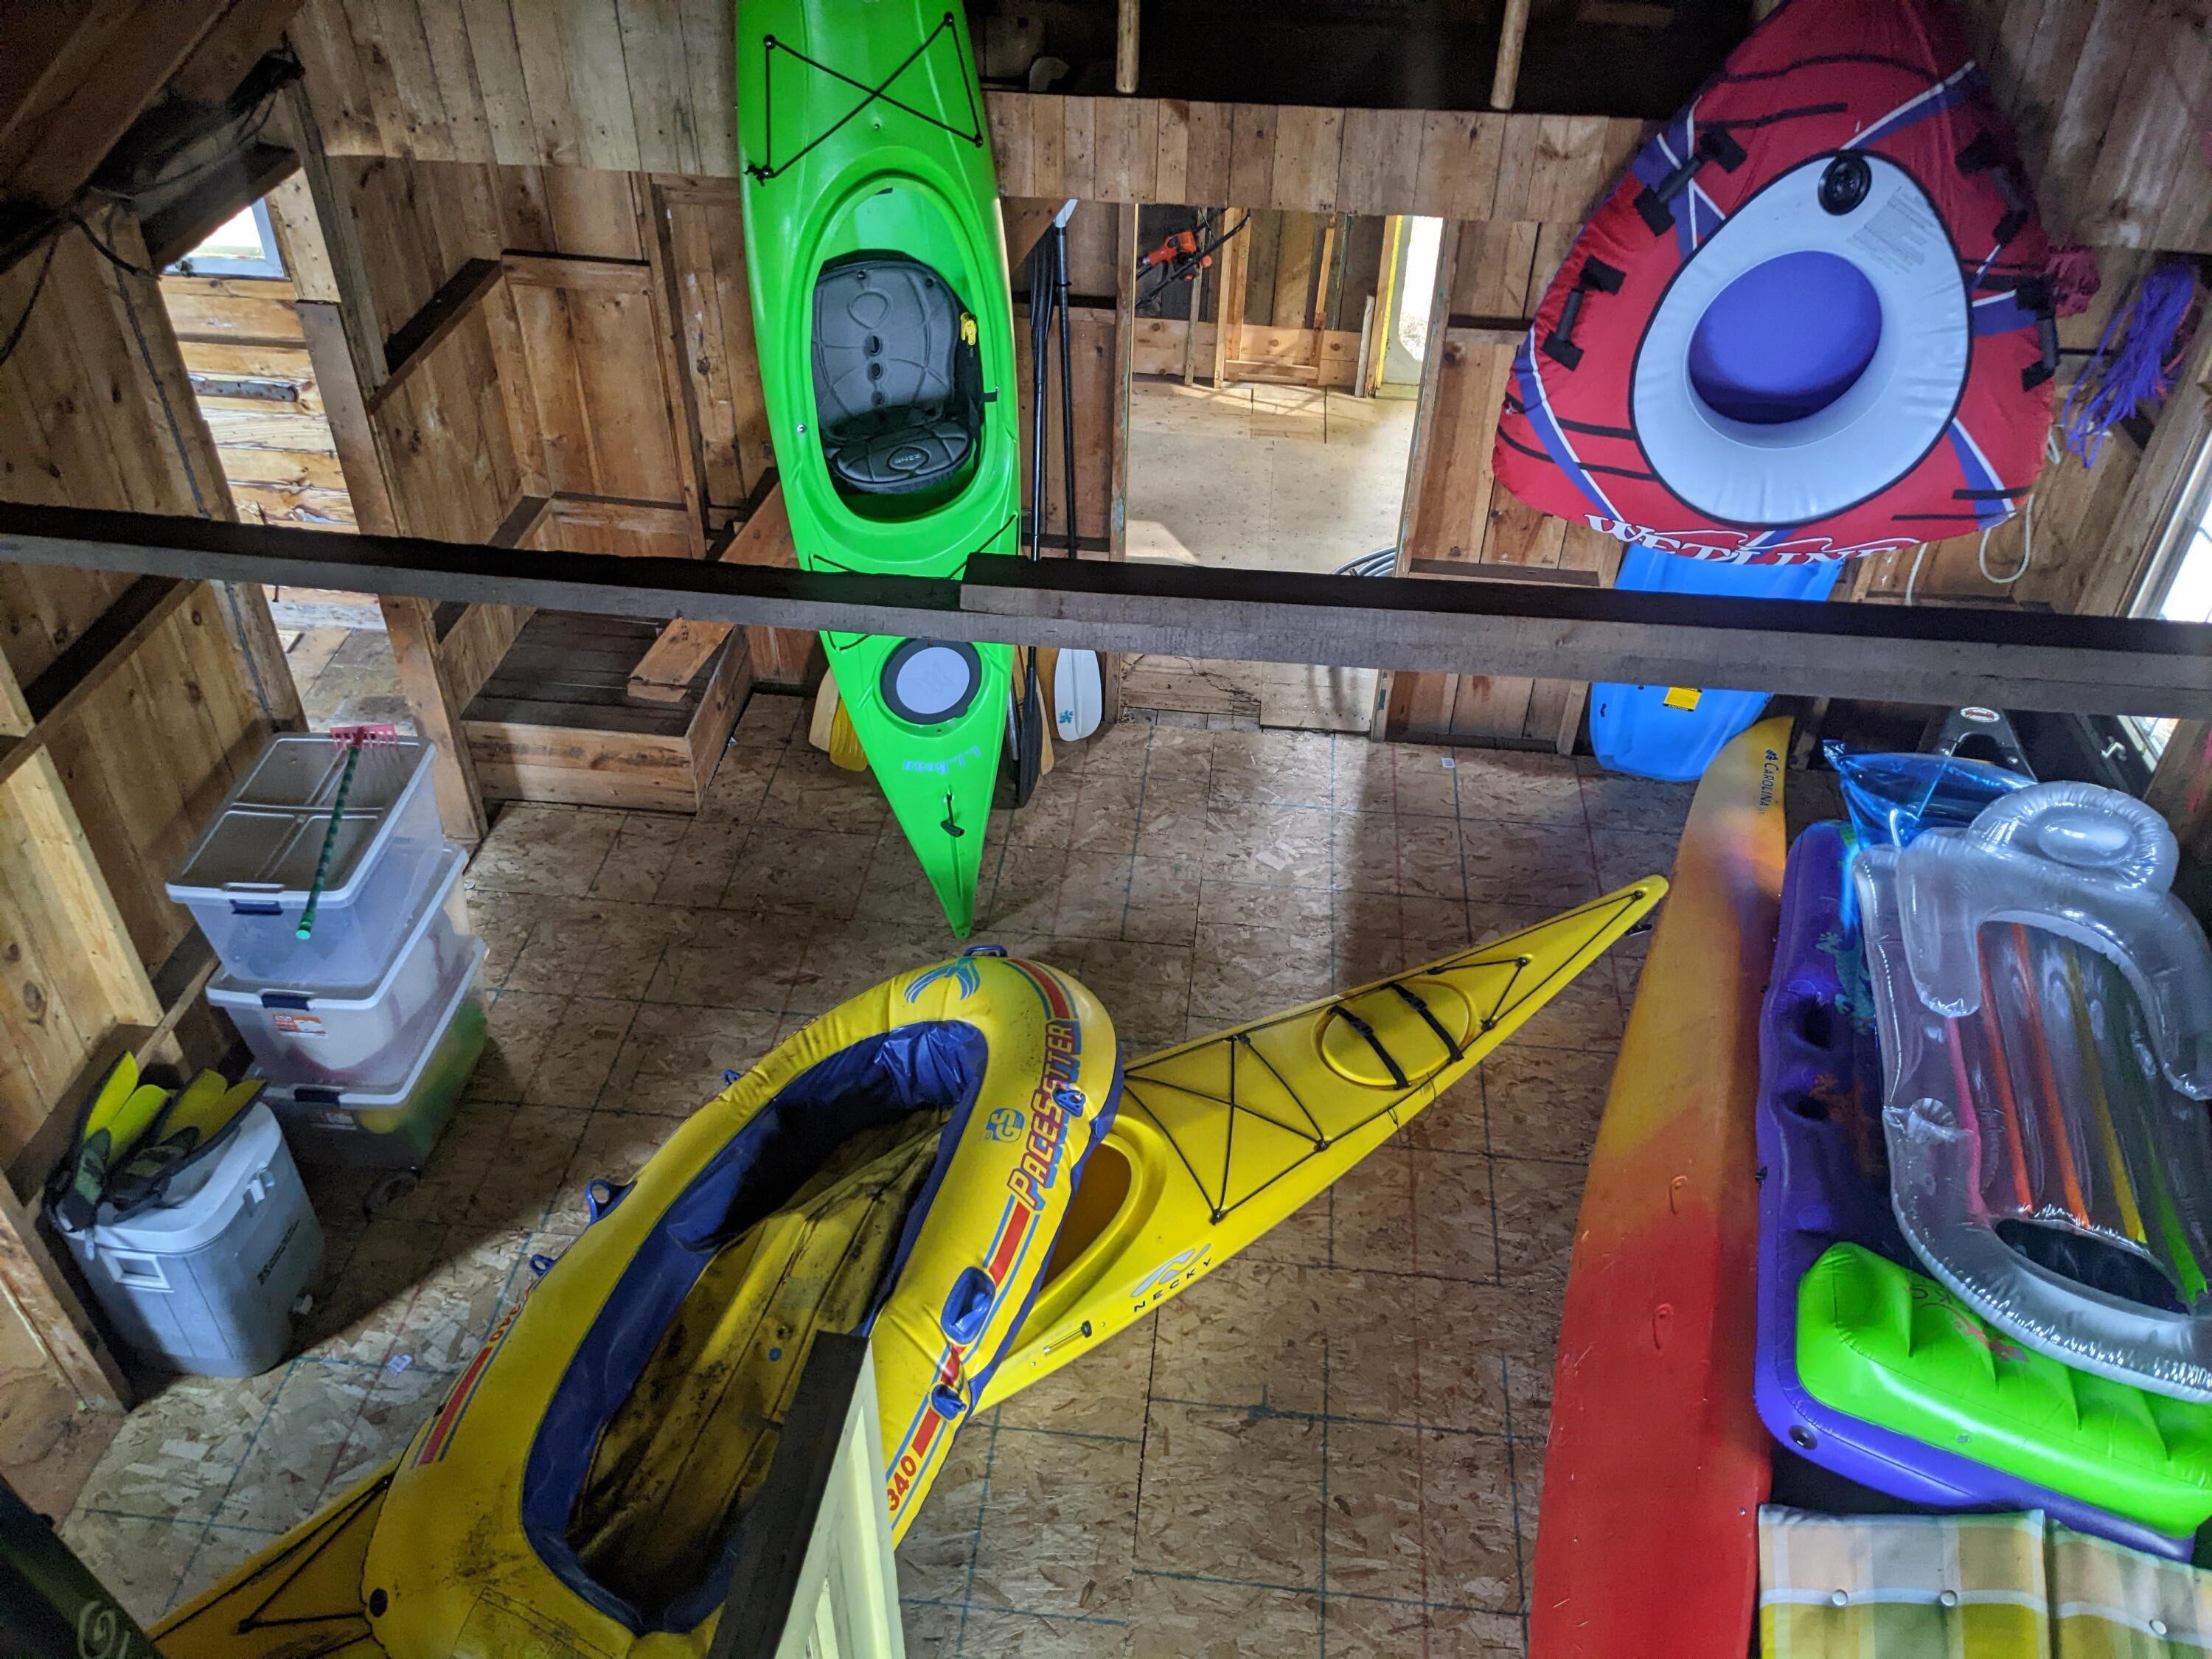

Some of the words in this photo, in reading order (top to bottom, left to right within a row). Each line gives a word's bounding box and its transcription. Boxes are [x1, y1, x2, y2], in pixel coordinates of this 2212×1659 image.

[1759, 762, 1779, 807] CAROLINA
[1007, 1020, 1081, 1211] PACESETTER
[1134, 1257, 1211, 1312] NECKY
[887, 1455, 917, 1511] 340
